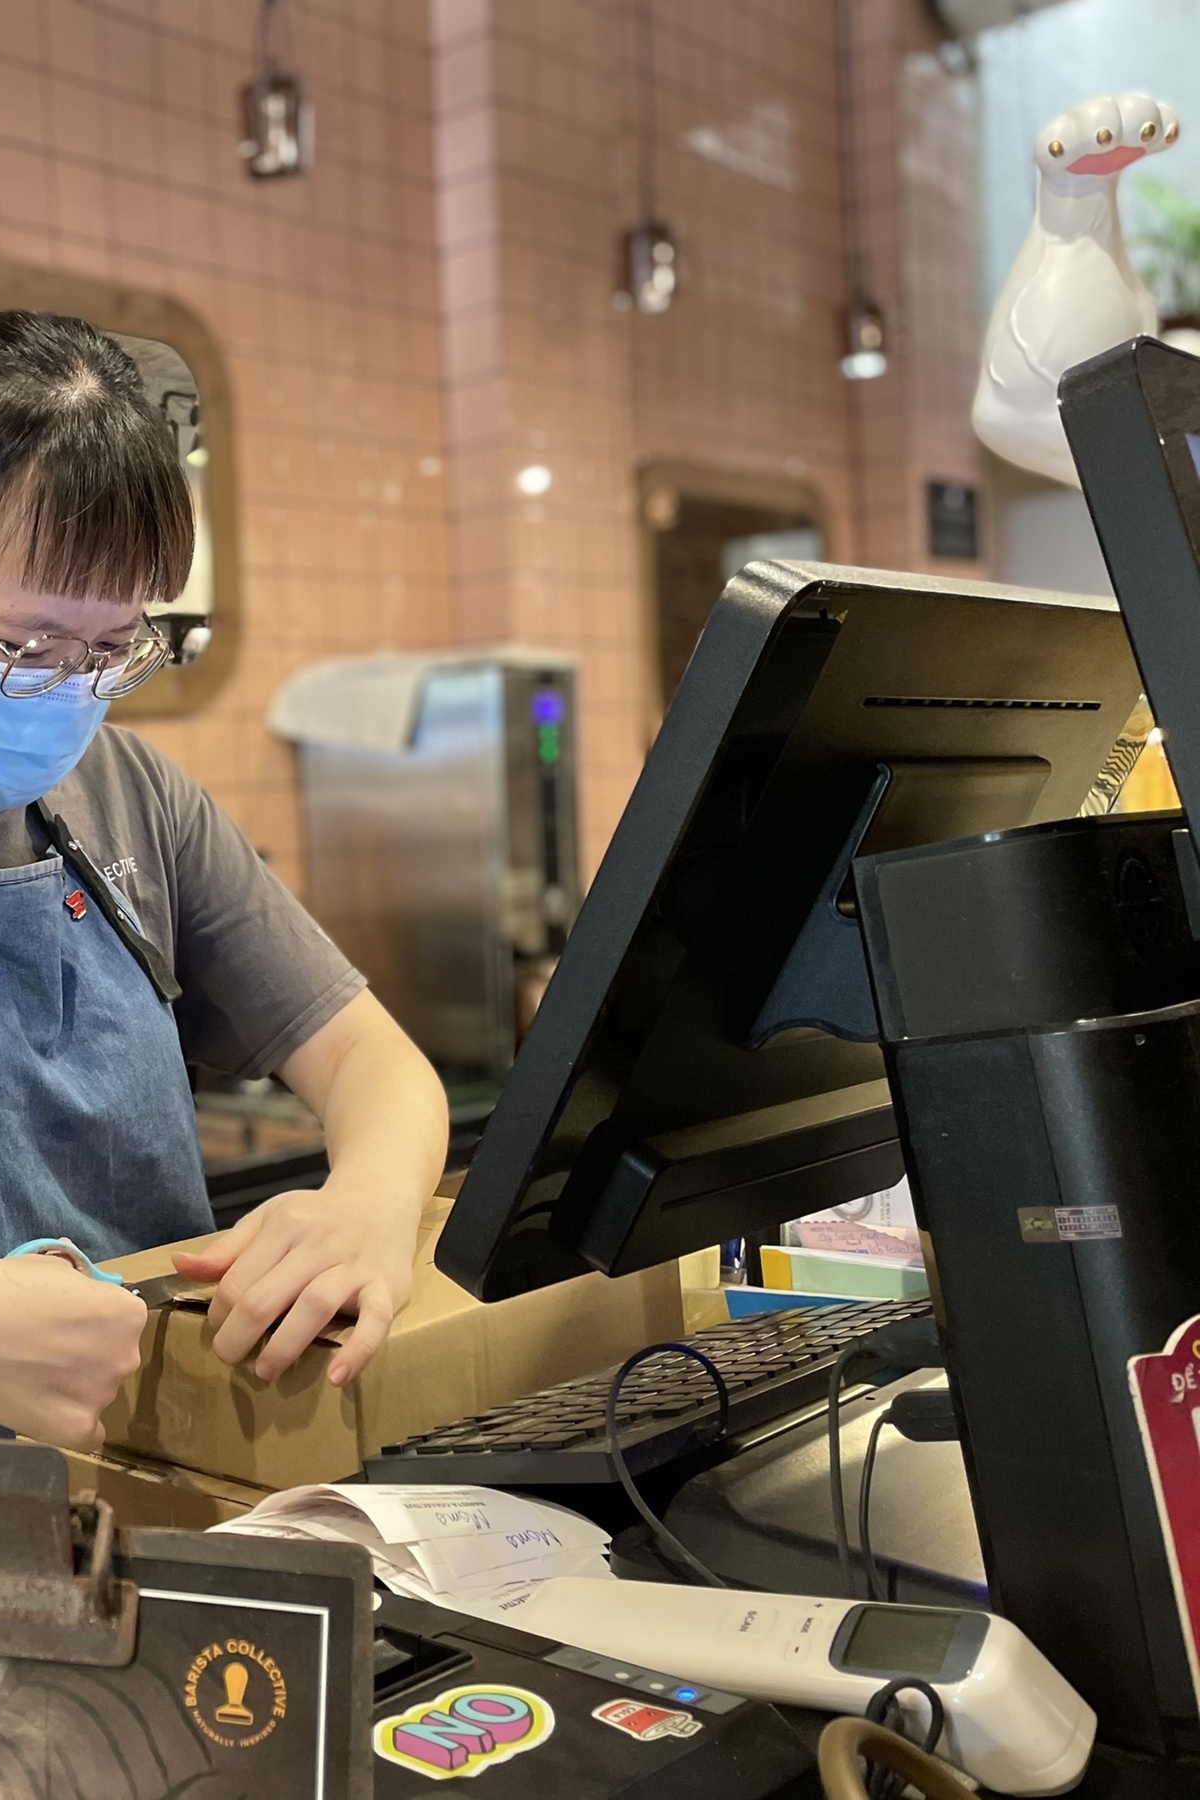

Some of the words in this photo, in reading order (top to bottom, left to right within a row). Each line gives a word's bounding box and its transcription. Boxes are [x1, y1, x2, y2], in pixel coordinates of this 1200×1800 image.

[739, 1610, 758, 1632] SCAN
[185, 1643, 224, 1707] BARISTA
[226, 1639, 287, 1719] COLLECTIVE
[192, 1710, 235, 1747] NATURALLY
[393, 1693, 534, 1771] NO
